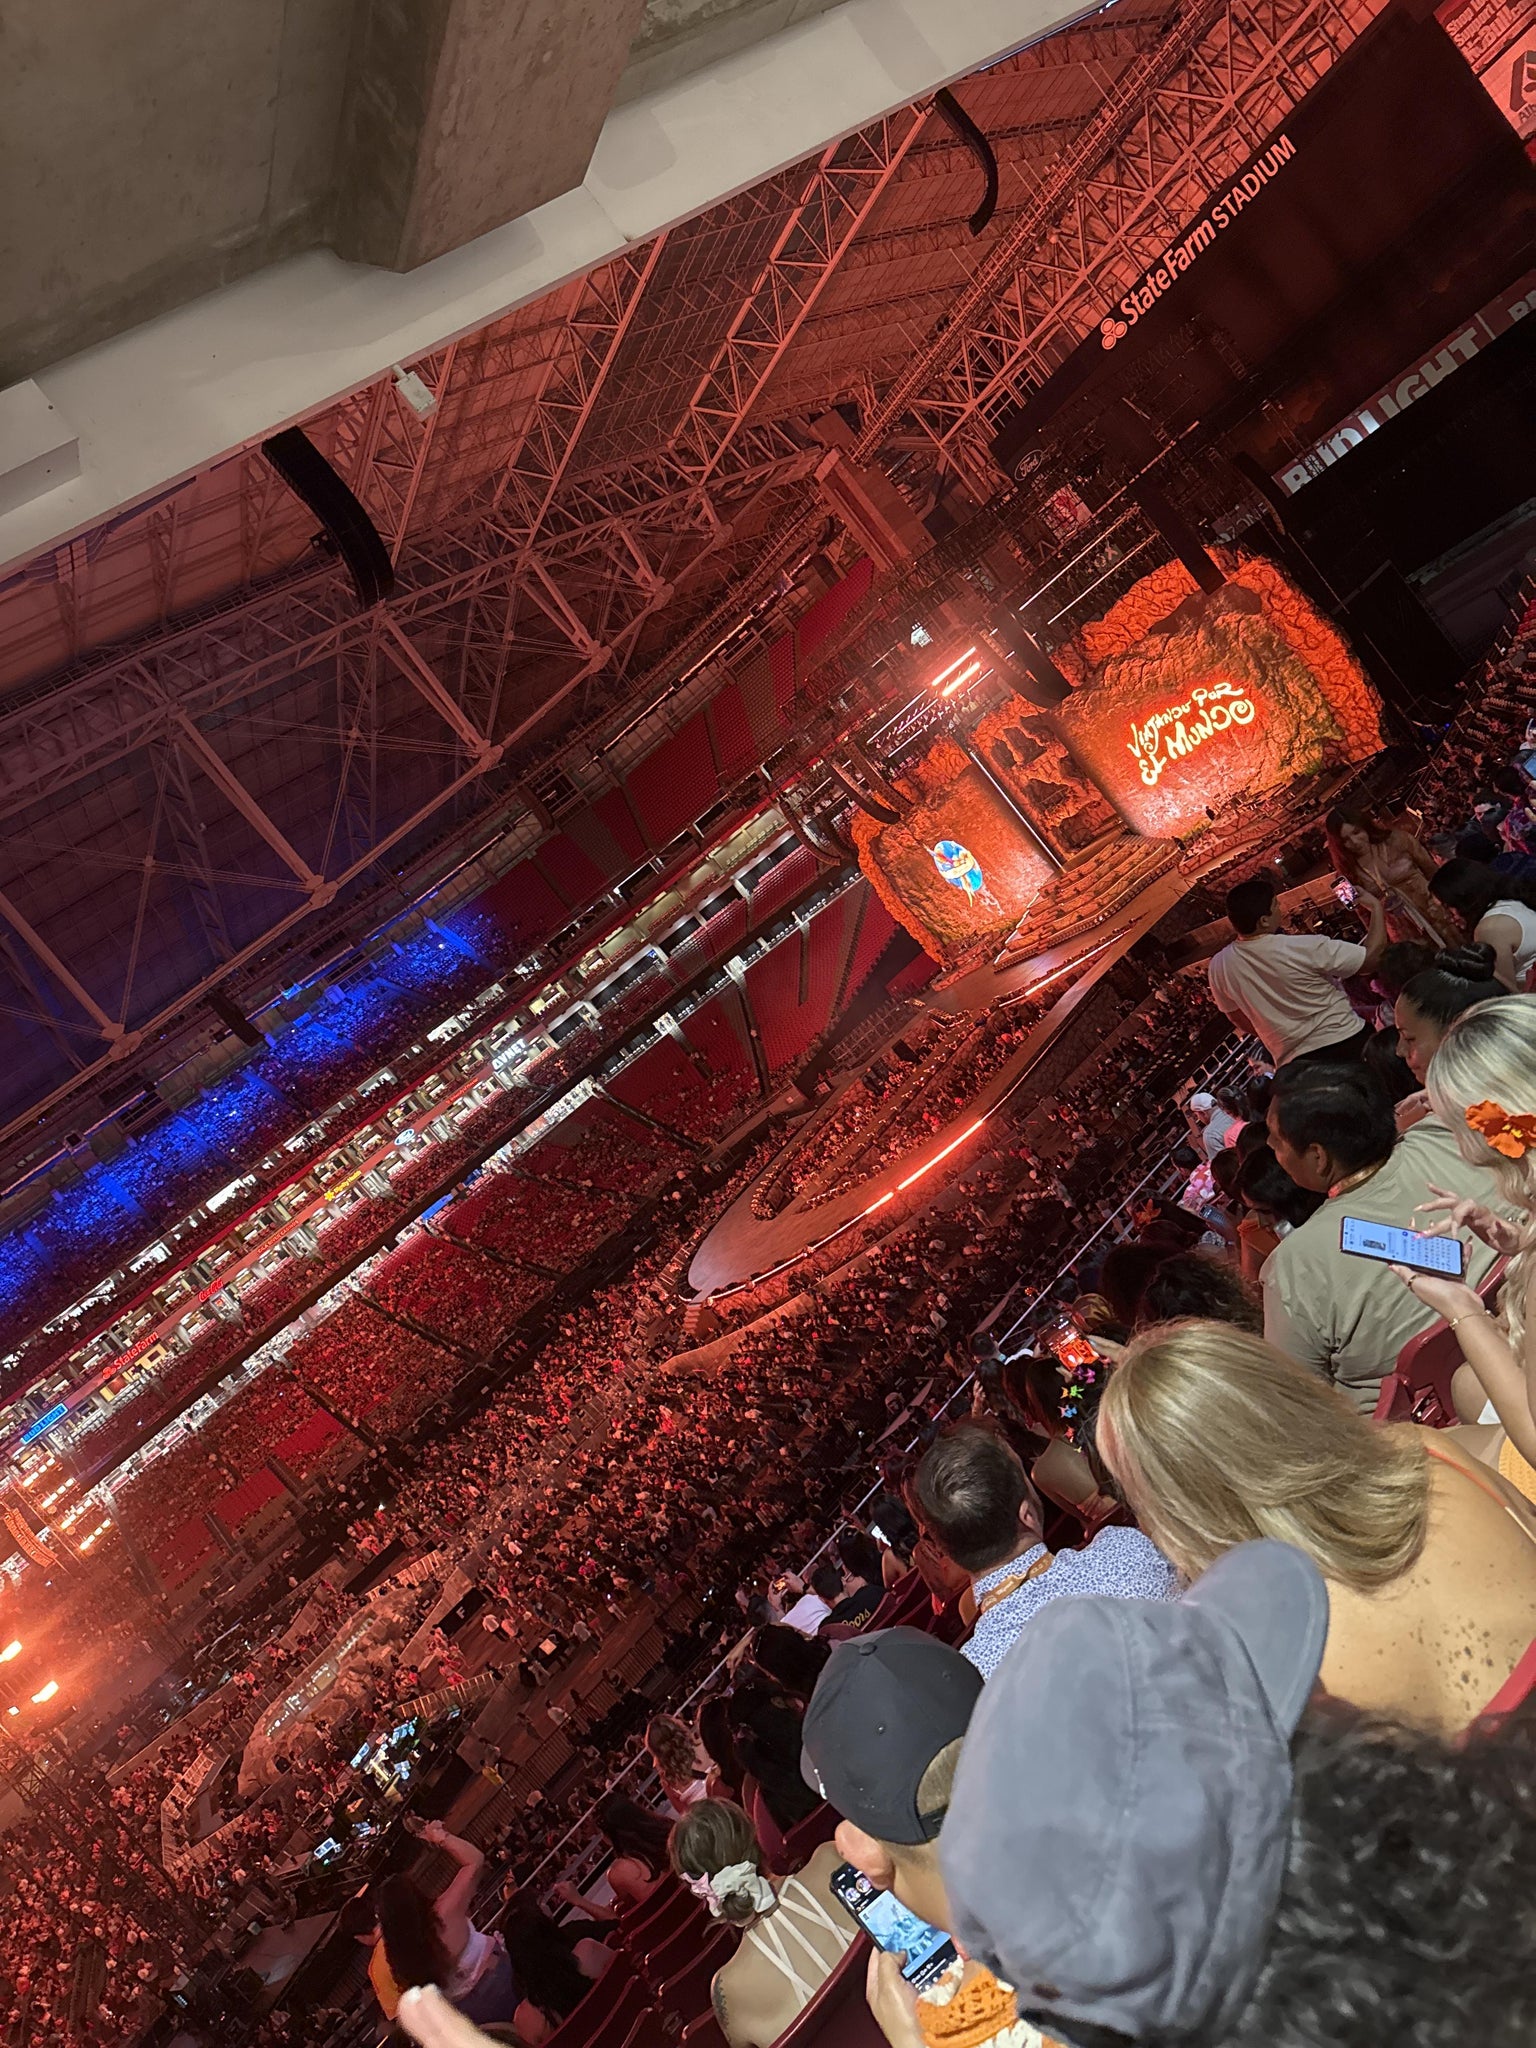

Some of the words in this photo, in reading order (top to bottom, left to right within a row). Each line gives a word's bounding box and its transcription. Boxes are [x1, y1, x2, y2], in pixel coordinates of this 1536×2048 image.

[1211, 134, 1297, 229] STADIUM
[492, 1038, 526, 1070] AVNET
[23, 1424, 41, 1441] BUD
[39, 1404, 65, 1427] LIGHT
